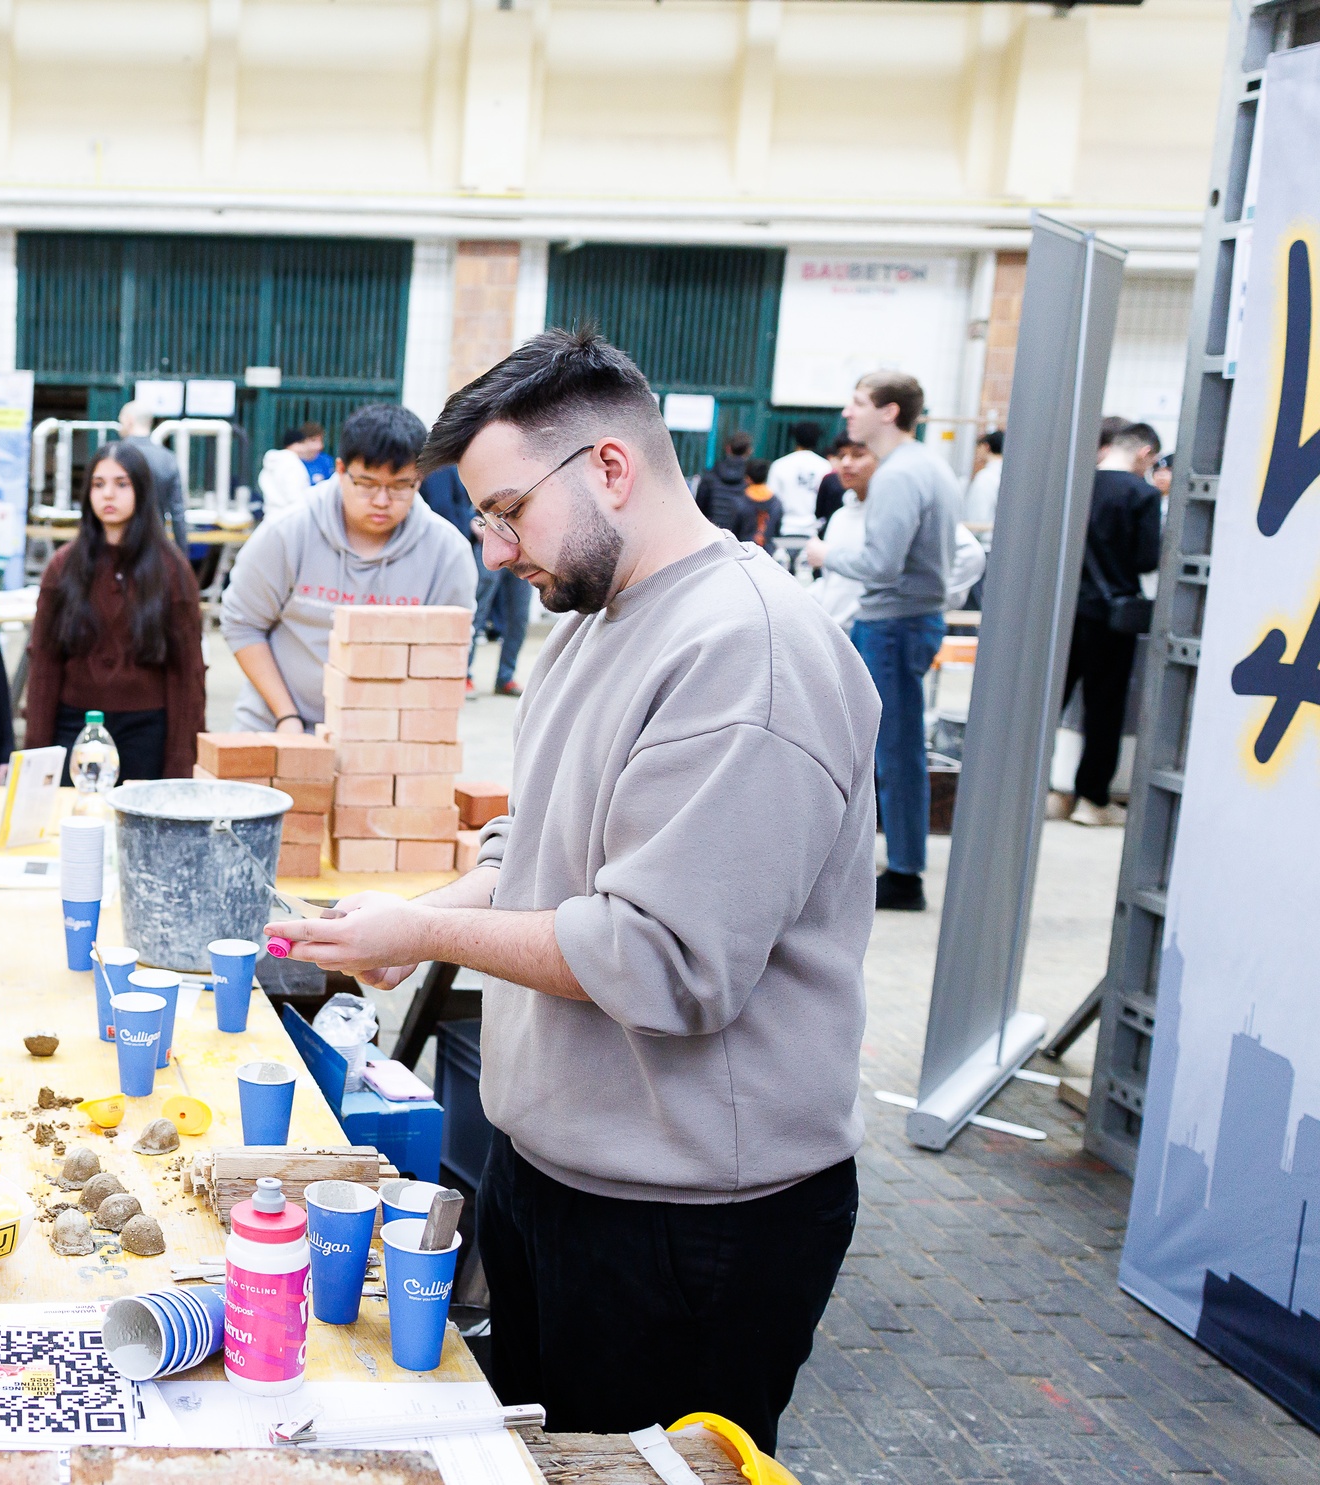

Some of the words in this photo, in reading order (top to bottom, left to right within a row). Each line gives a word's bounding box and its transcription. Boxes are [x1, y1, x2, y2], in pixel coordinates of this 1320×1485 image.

[317, 585, 355, 604] TOM
[309, 1231, 351, 1256] ulligan
[240, 1282, 277, 1295] CYCLING
